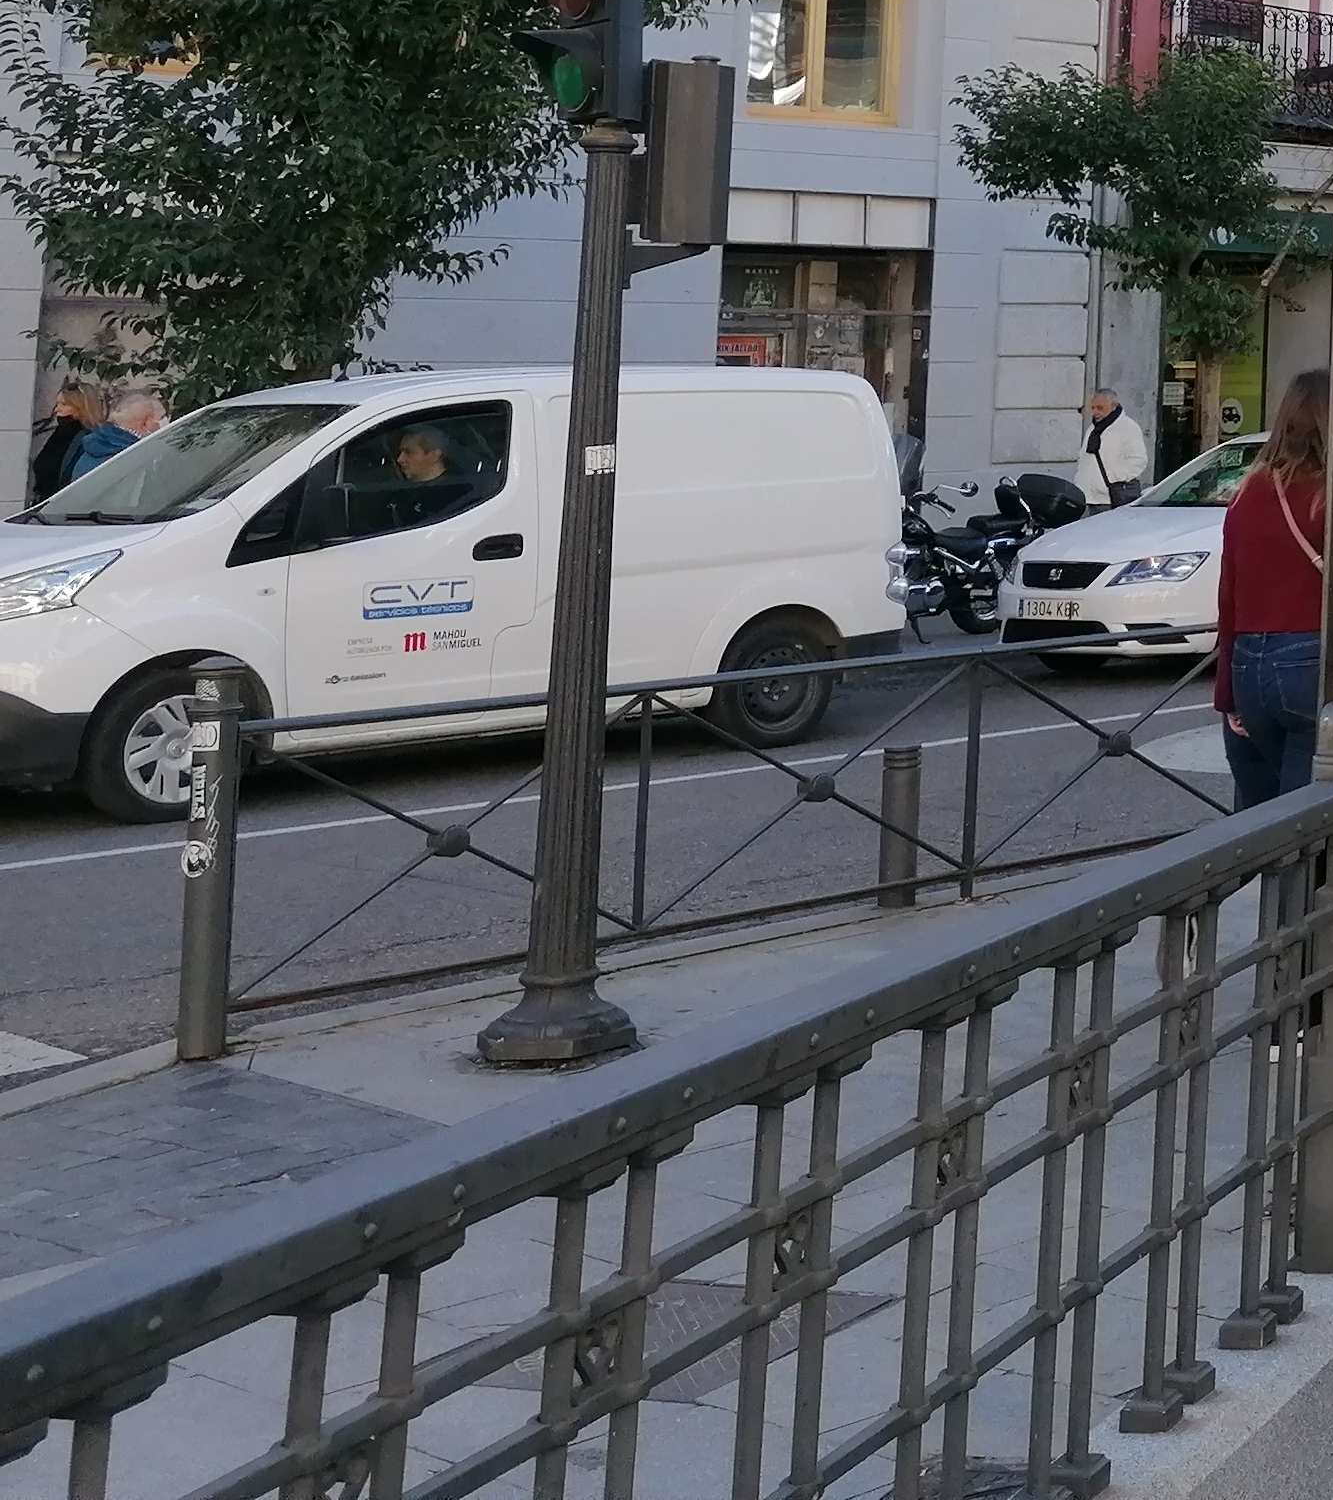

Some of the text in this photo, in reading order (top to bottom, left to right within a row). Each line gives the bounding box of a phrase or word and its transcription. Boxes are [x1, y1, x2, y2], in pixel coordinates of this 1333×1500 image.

[369, 580, 468, 605] CVT
[1027, 601, 1053, 617] 1304
[433, 629, 467, 641] MAHOU
